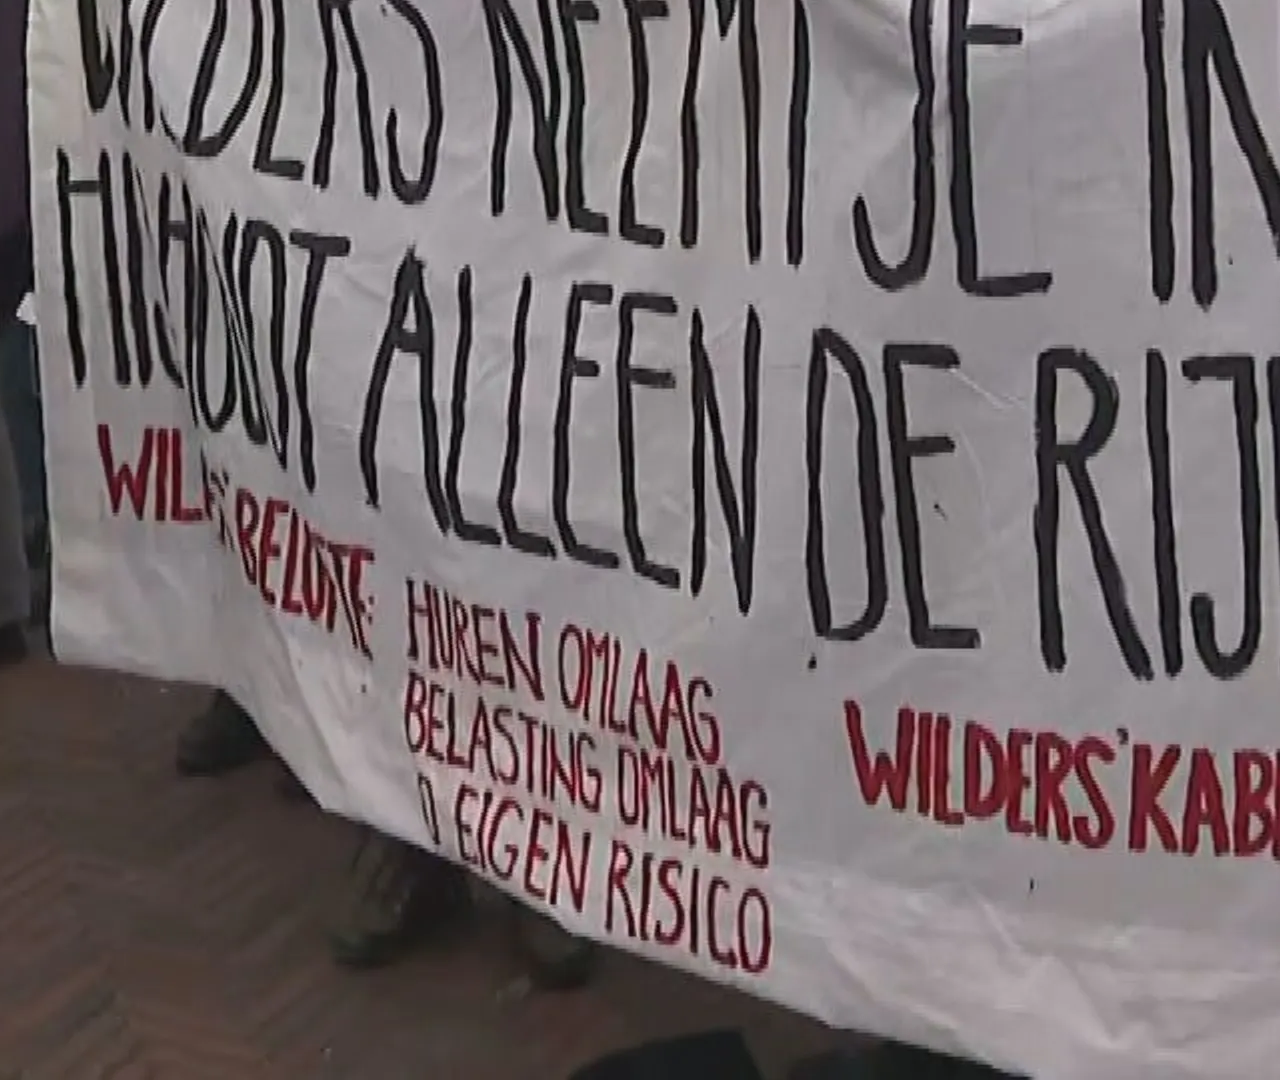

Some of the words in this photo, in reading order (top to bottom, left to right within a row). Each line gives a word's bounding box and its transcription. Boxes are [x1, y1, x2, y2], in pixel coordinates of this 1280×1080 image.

[358, 245, 762, 617] ALLEEN
[806, 325, 982, 650] DE
[406, 576, 545, 701] HUREN
[558, 624, 721, 766] OMLAAG
[404, 669, 602, 813] BELASTING
[617, 743, 771, 869] OMLAAG
[454, 783, 591, 912] EIGEN
[605, 839, 771, 974] RISICO
